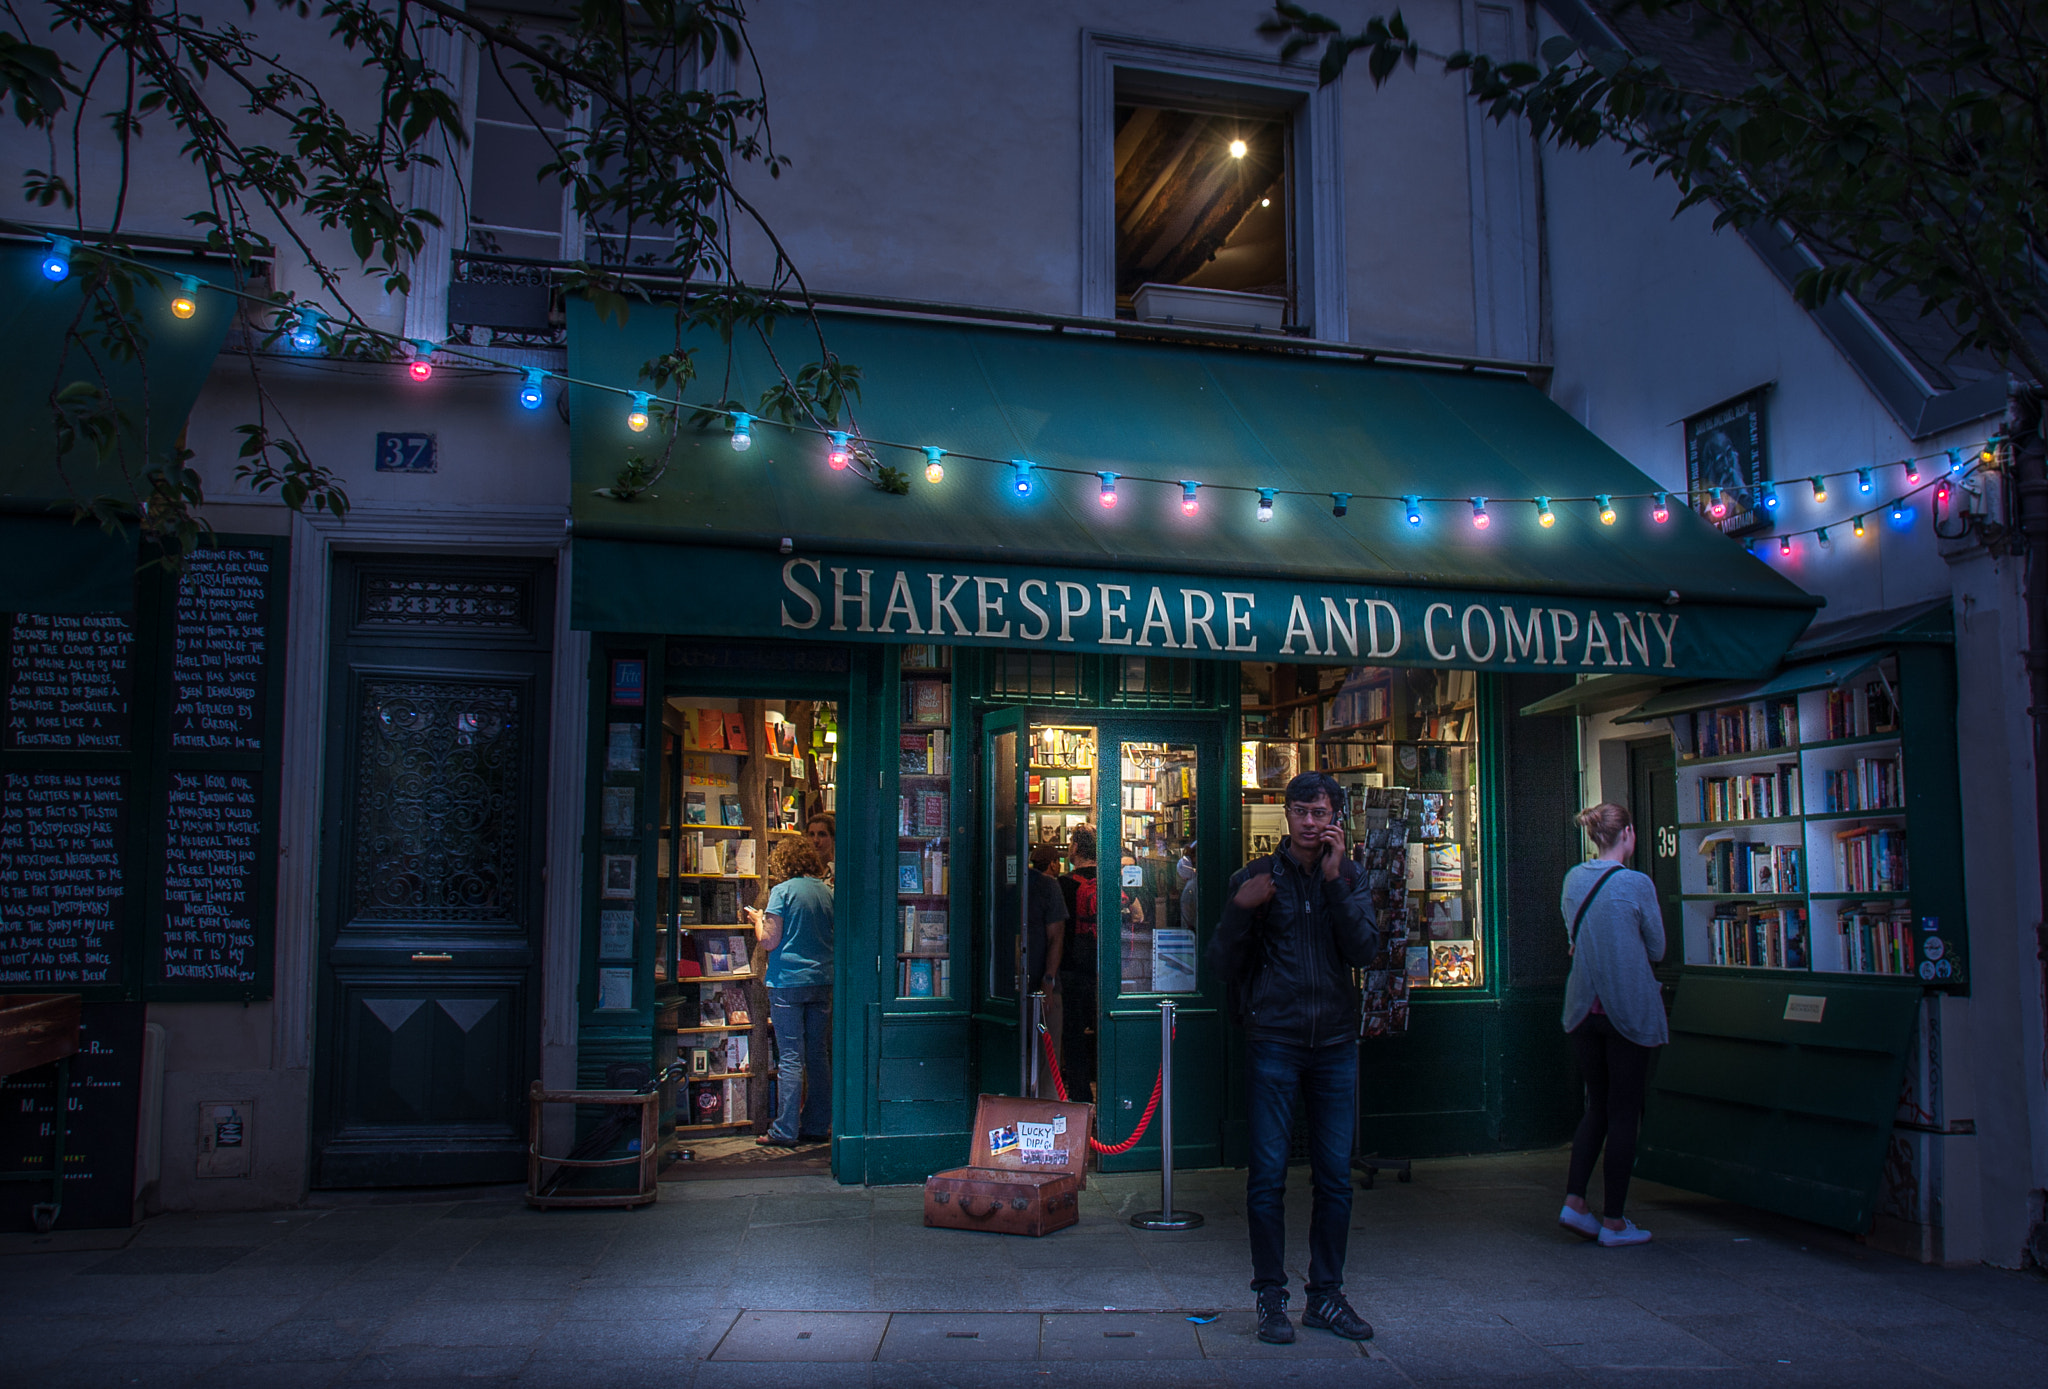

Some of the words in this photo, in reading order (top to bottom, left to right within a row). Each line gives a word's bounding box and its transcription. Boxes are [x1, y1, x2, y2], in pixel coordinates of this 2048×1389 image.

[385, 438, 428, 467] 37
[228, 550, 245, 560] FOR
[247, 550, 264, 560] THE
[225, 564, 241, 572] GIRL
[243, 563, 269, 572] CALLED
[180, 586, 194, 595] ONE
[201, 586, 236, 597] HUNDRED
[238, 588, 265, 599] YEARS
[177, 597, 192, 607] AGO
[178, 610, 197, 620] WAS
[210, 612, 232, 621] WINE
[236, 612, 259, 622] SHOP
[780, 557, 1257, 653] SHAKESPEARE
[1279, 594, 1402, 659] AND
[1423, 602, 1680, 669] COMPANY
[31, 614, 49, 626] THE
[52, 616, 80, 628] LATIN
[82, 616, 129, 628] QUARTER
[12, 626, 48, 640] BECAUSE
[66, 631, 88, 641] HEAD
[118, 632, 136, 643] FAR
[177, 624, 205, 636] HIDDEN
[207, 625, 226, 637] FROM
[225, 625, 239, 638] THE
[242, 626, 265, 638] SEINE
[42, 644, 58, 654] THE
[62, 644, 94, 655] CLOUDS
[98, 646, 118, 656] THAT
[206, 640, 235, 650] ANNEX
[248, 642, 265, 652] THE
[12, 657, 28, 668] CAN
[34, 658, 66, 669] IMAGINE
[68, 659, 84, 669] ALL
[111, 660, 127, 669] ARE
[176, 654, 200, 667] HOTEL
[201, 655, 221, 665] DIEU
[223, 651, 263, 668] HOSPITAL
[18, 671, 54, 682] ANGELS
[71, 672, 116, 684] PARADISE,
[173, 671, 203, 681] WHICH
[207, 671, 224, 682] HAS
[229, 671, 256, 682] SINCE
[9, 684, 30, 696] AND
[36, 686, 69, 696] INSTEAD
[84, 686, 109, 698] BEING
[179, 685, 202, 699] BEEN
[207, 686, 255, 699] DEMOLISHED
[8, 698, 54, 711] BONAFIDE
[60, 700, 118, 712] BOOKSELLER
[174, 703, 193, 714] AND
[195, 701, 234, 716] REPLACED
[36, 716, 61, 727] MORE
[64, 717, 85, 728] LIKE
[201, 717, 242, 732] GARDEN.
[16, 731, 72, 745] FRUSTRATED
[78, 733, 122, 746] NOVELIST.
[172, 732, 210, 747] FURTHER
[210, 734, 232, 747] BACK
[246, 738, 261, 749] THE
[5, 773, 29, 788] THIS
[34, 775, 61, 786] STORE
[64, 775, 81, 786] HAS
[85, 775, 121, 786] ROOMS
[174, 773, 201, 790] YEAR
[231, 776, 252, 789] OUR
[4, 790, 22, 802] LIKE
[93, 791, 123, 801] NOVEL
[168, 790, 196, 802] WHOLE
[198, 790, 234, 805] BUILDING
[236, 793, 255, 803] WAS
[2, 806, 23, 819] AND
[26, 807, 42, 817] THE
[45, 805, 66, 818] FACT
[79, 804, 118, 820] TOLSTOI
[178, 806, 220, 820] MONASTERY
[224, 808, 252, 818] CALLED
[1, 822, 22, 834] AND
[27, 820, 91, 838] DOSTOYEVSKY
[93, 821, 113, 832] ARE
[1, 837, 24, 850] MORE
[31, 837, 55, 851] REAL
[90, 838, 113, 849] THAN
[224, 835, 251, 846] TIMES
[16, 854, 39, 865] NEXT
[40, 854, 64, 866] DOOR
[65, 852, 118, 865] NEIGHBOURS
[166, 849, 186, 859] EACH
[189, 849, 237, 865] MONASTERY
[238, 850, 255, 862] HAD
[0, 870, 19, 882] AND
[23, 870, 46, 881] EVEN
[49, 868, 94, 881] STRANGER
[165, 876, 192, 887] WHOSE
[194, 877, 213, 891] DUTY
[214, 878, 231, 889] WAS
[12, 887, 28, 898] THE
[32, 885, 50, 897] FACT
[51, 885, 73, 897] THAT
[73, 886, 95, 896] EVEN
[96, 885, 124, 897] BEFORE
[165, 888, 188, 901] LIGHT
[189, 890, 203, 901] THE
[206, 890, 231, 903] LAMPS
[4, 904, 25, 916] WAS
[26, 904, 50, 916] BORN
[27, 921, 44, 932] THE
[47, 920, 71, 935] STORY
[97, 920, 115, 932] LIFE
[174, 915, 197, 927] HAVE
[199, 917, 221, 929] BEEN
[223, 918, 251, 929] DOING
[20, 937, 44, 949] BOOK
[47, 938, 78, 949] CALLED
[164, 931, 182, 942] THIS
[185, 931, 201, 943] FOR
[203, 931, 226, 949] FIFTY
[229, 933, 255, 947] YEARS
[32, 953, 54, 964] AND
[59, 952, 81, 964] EVER
[86, 953, 111, 965] SINCE
[164, 946, 187, 961] NOW
[55, 970, 79, 981] HAVE
[81, 968, 108, 981] BEEN
[1022, 1125, 1051, 1138] LUCKY
[1027, 1138, 1043, 1149] DIP!
